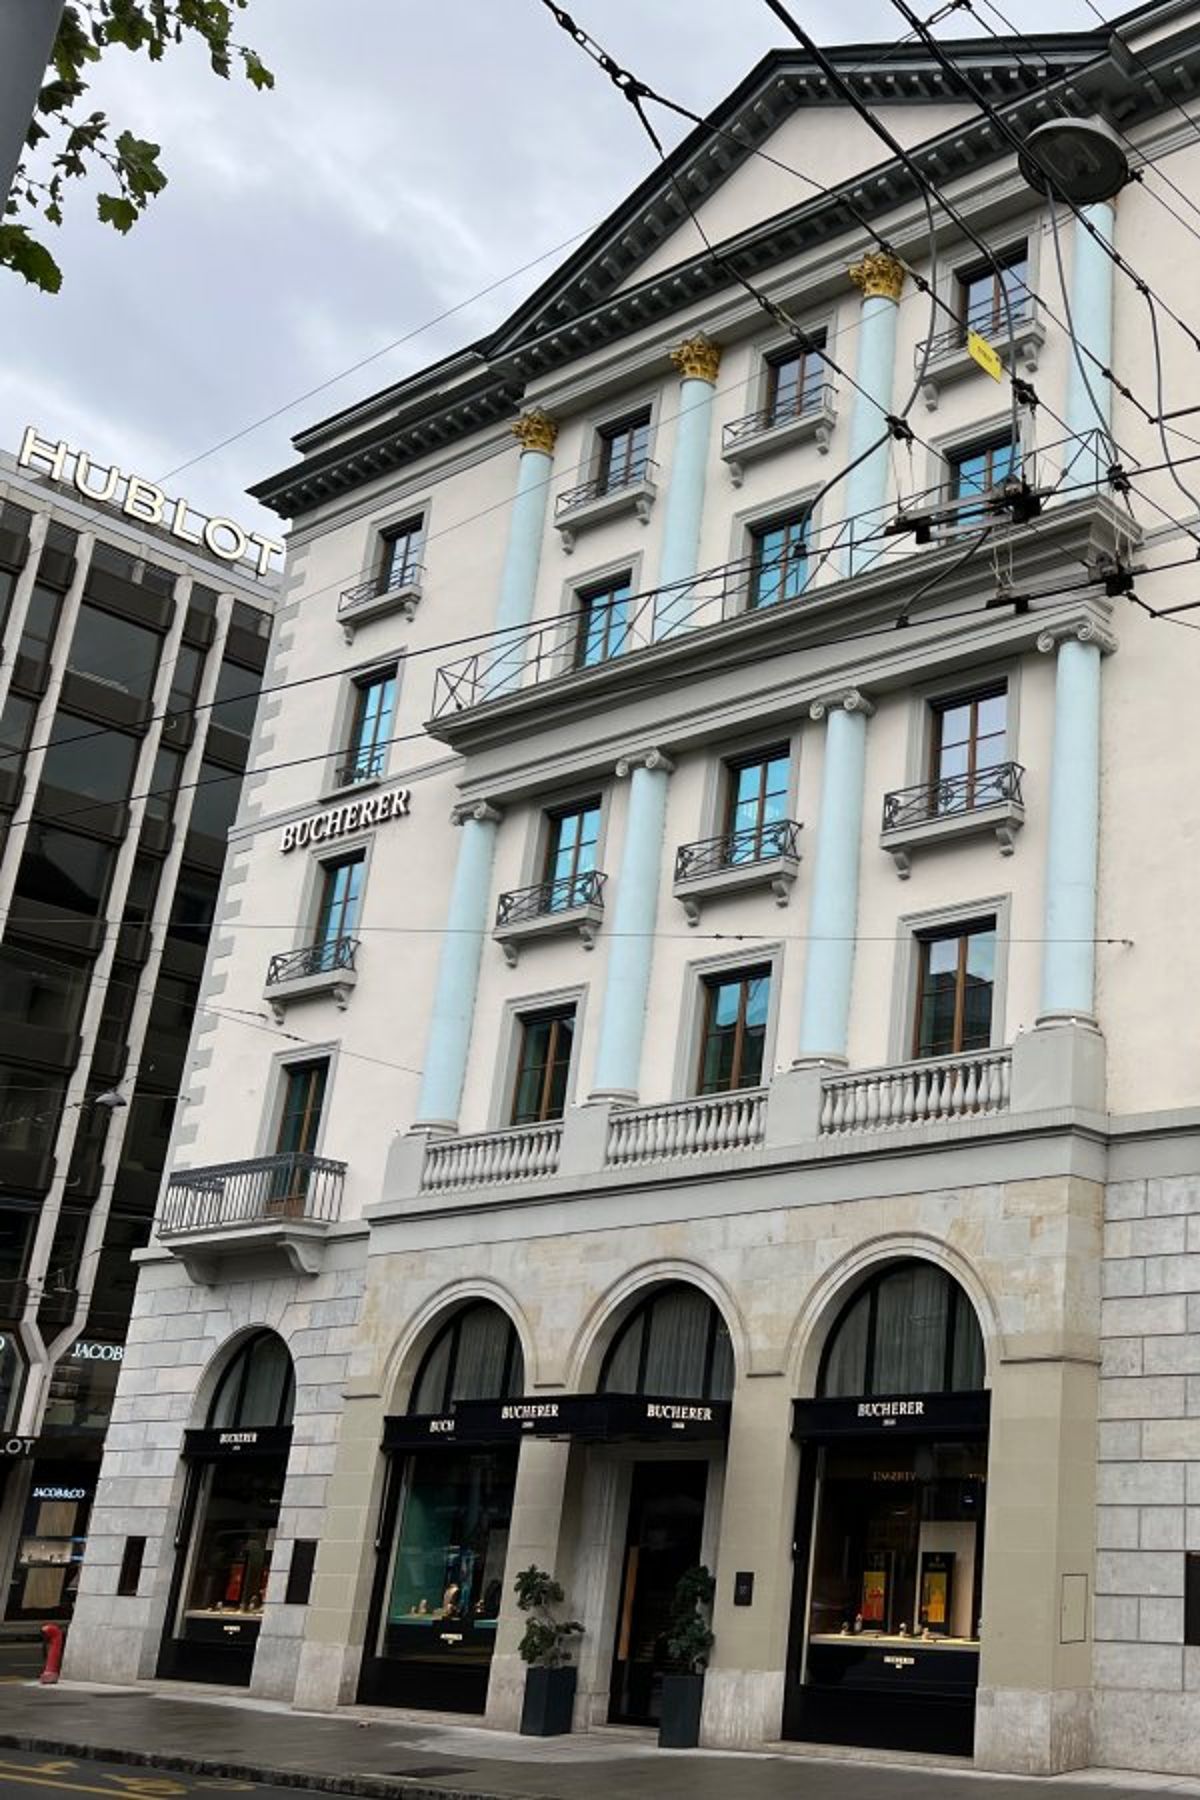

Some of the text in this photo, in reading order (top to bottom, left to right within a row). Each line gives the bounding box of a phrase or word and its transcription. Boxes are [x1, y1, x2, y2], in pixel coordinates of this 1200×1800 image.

[18, 426, 283, 577] HUBLOT
[279, 788, 411, 854] BUCHERER
[71, 1343, 123, 1361] JACOB
[501, 1404, 559, 1419] BUCHERER
[647, 1403, 712, 1421] BUCHERER
[857, 1401, 925, 1417] BUCHERER
[0, 1438, 35, 1455] OT
